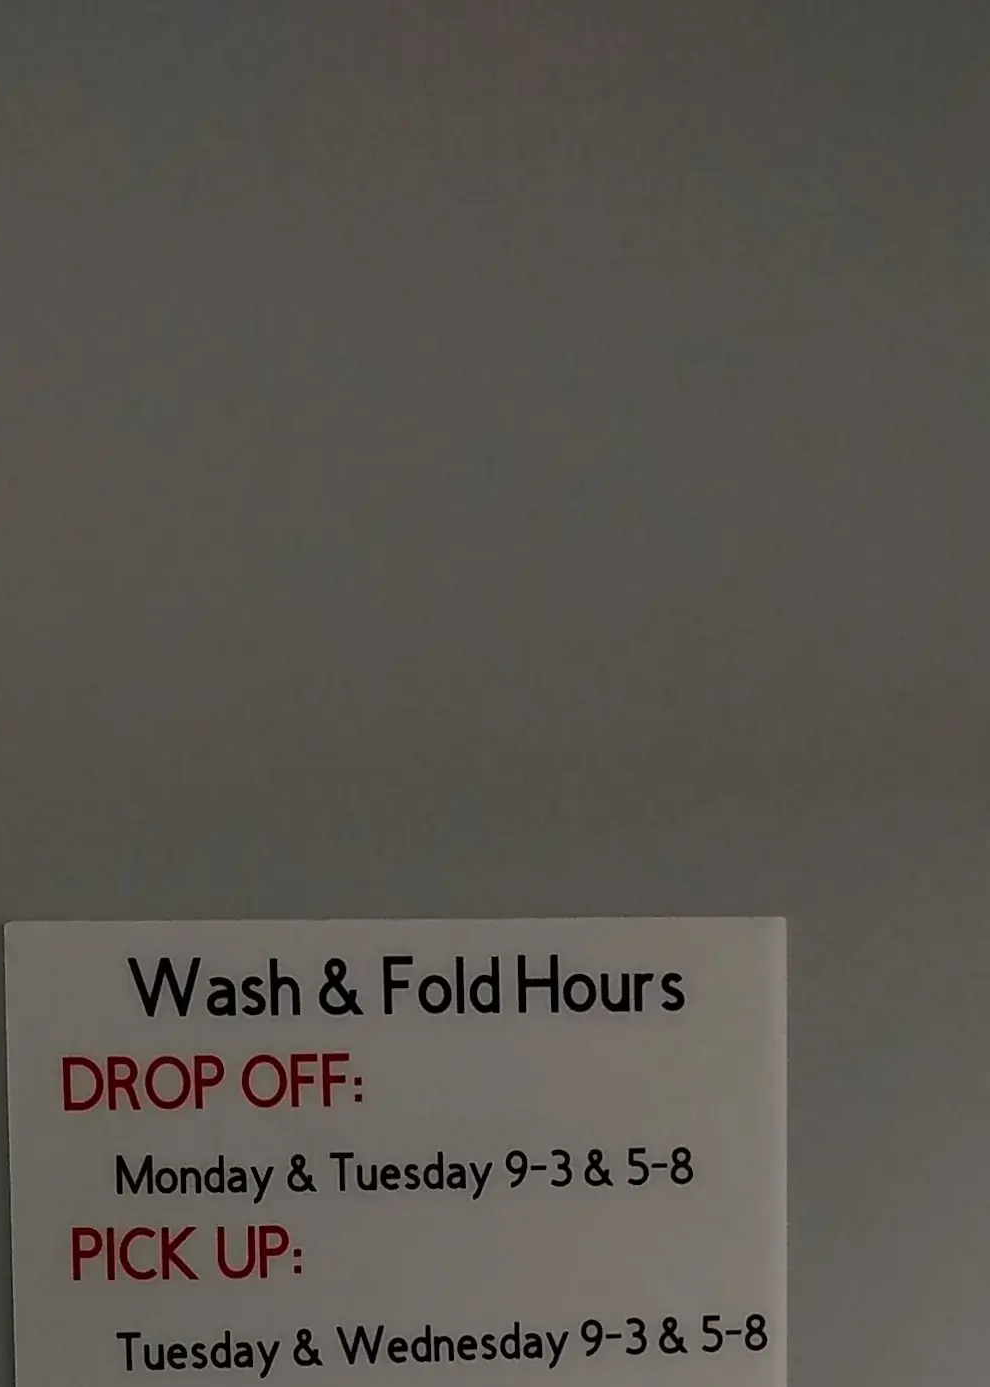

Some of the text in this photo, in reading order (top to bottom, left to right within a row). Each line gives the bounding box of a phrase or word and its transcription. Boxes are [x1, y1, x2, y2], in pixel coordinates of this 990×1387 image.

[127, 954, 685, 1018] Wash & Fold Hours
[62, 1052, 363, 1112] DROP OFF:
[115, 1146, 694, 1205] Monday & Tuesday 9-3 & 5-8
[72, 1225, 302, 1281] PICK UP:
[115, 1313, 768, 1379] Tuesday & Wednesday 9-3 & 5-8
